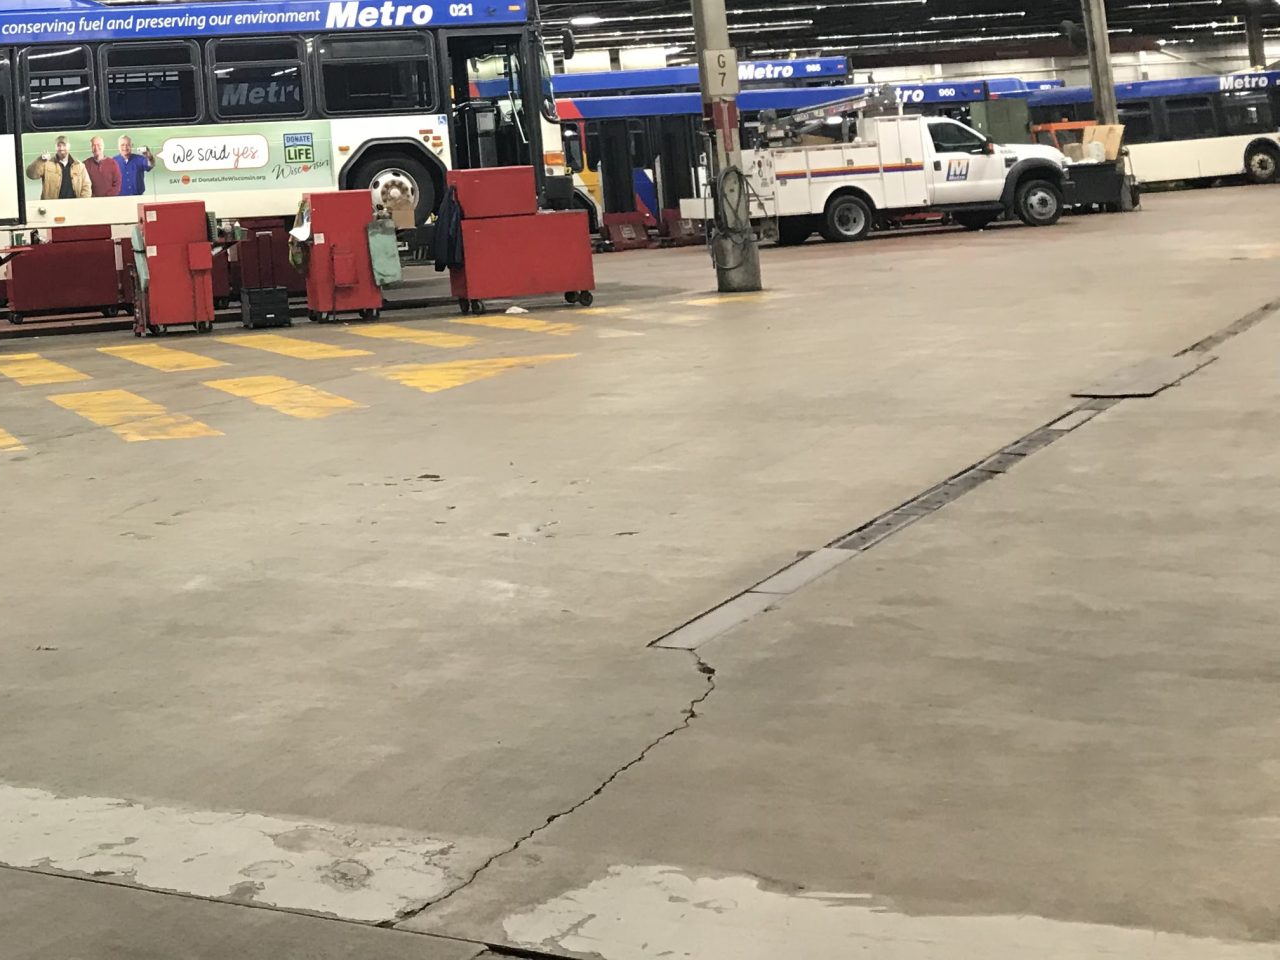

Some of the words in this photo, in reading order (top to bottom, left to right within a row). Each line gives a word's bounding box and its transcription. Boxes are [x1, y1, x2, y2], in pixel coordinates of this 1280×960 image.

[325, 0, 434, 28] Metro
[449, 3, 474, 17] 021
[1, 19, 75, 35] conserving
[78, 16, 104, 31] fuel
[106, 15, 133, 30] and
[135, 13, 206, 32] preserving
[209, 13, 232, 26] our
[234, 9, 320, 25] environment
[717, 54, 726, 69] G
[718, 72, 726, 87] 7
[738, 64, 794, 80] Metro
[1220, 75, 1269, 90] Metro
[938, 88, 955, 97] 960
[285, 135, 311, 144] DONATE
[198, 144, 230, 160] said
[287, 147, 312, 161] LIFE
